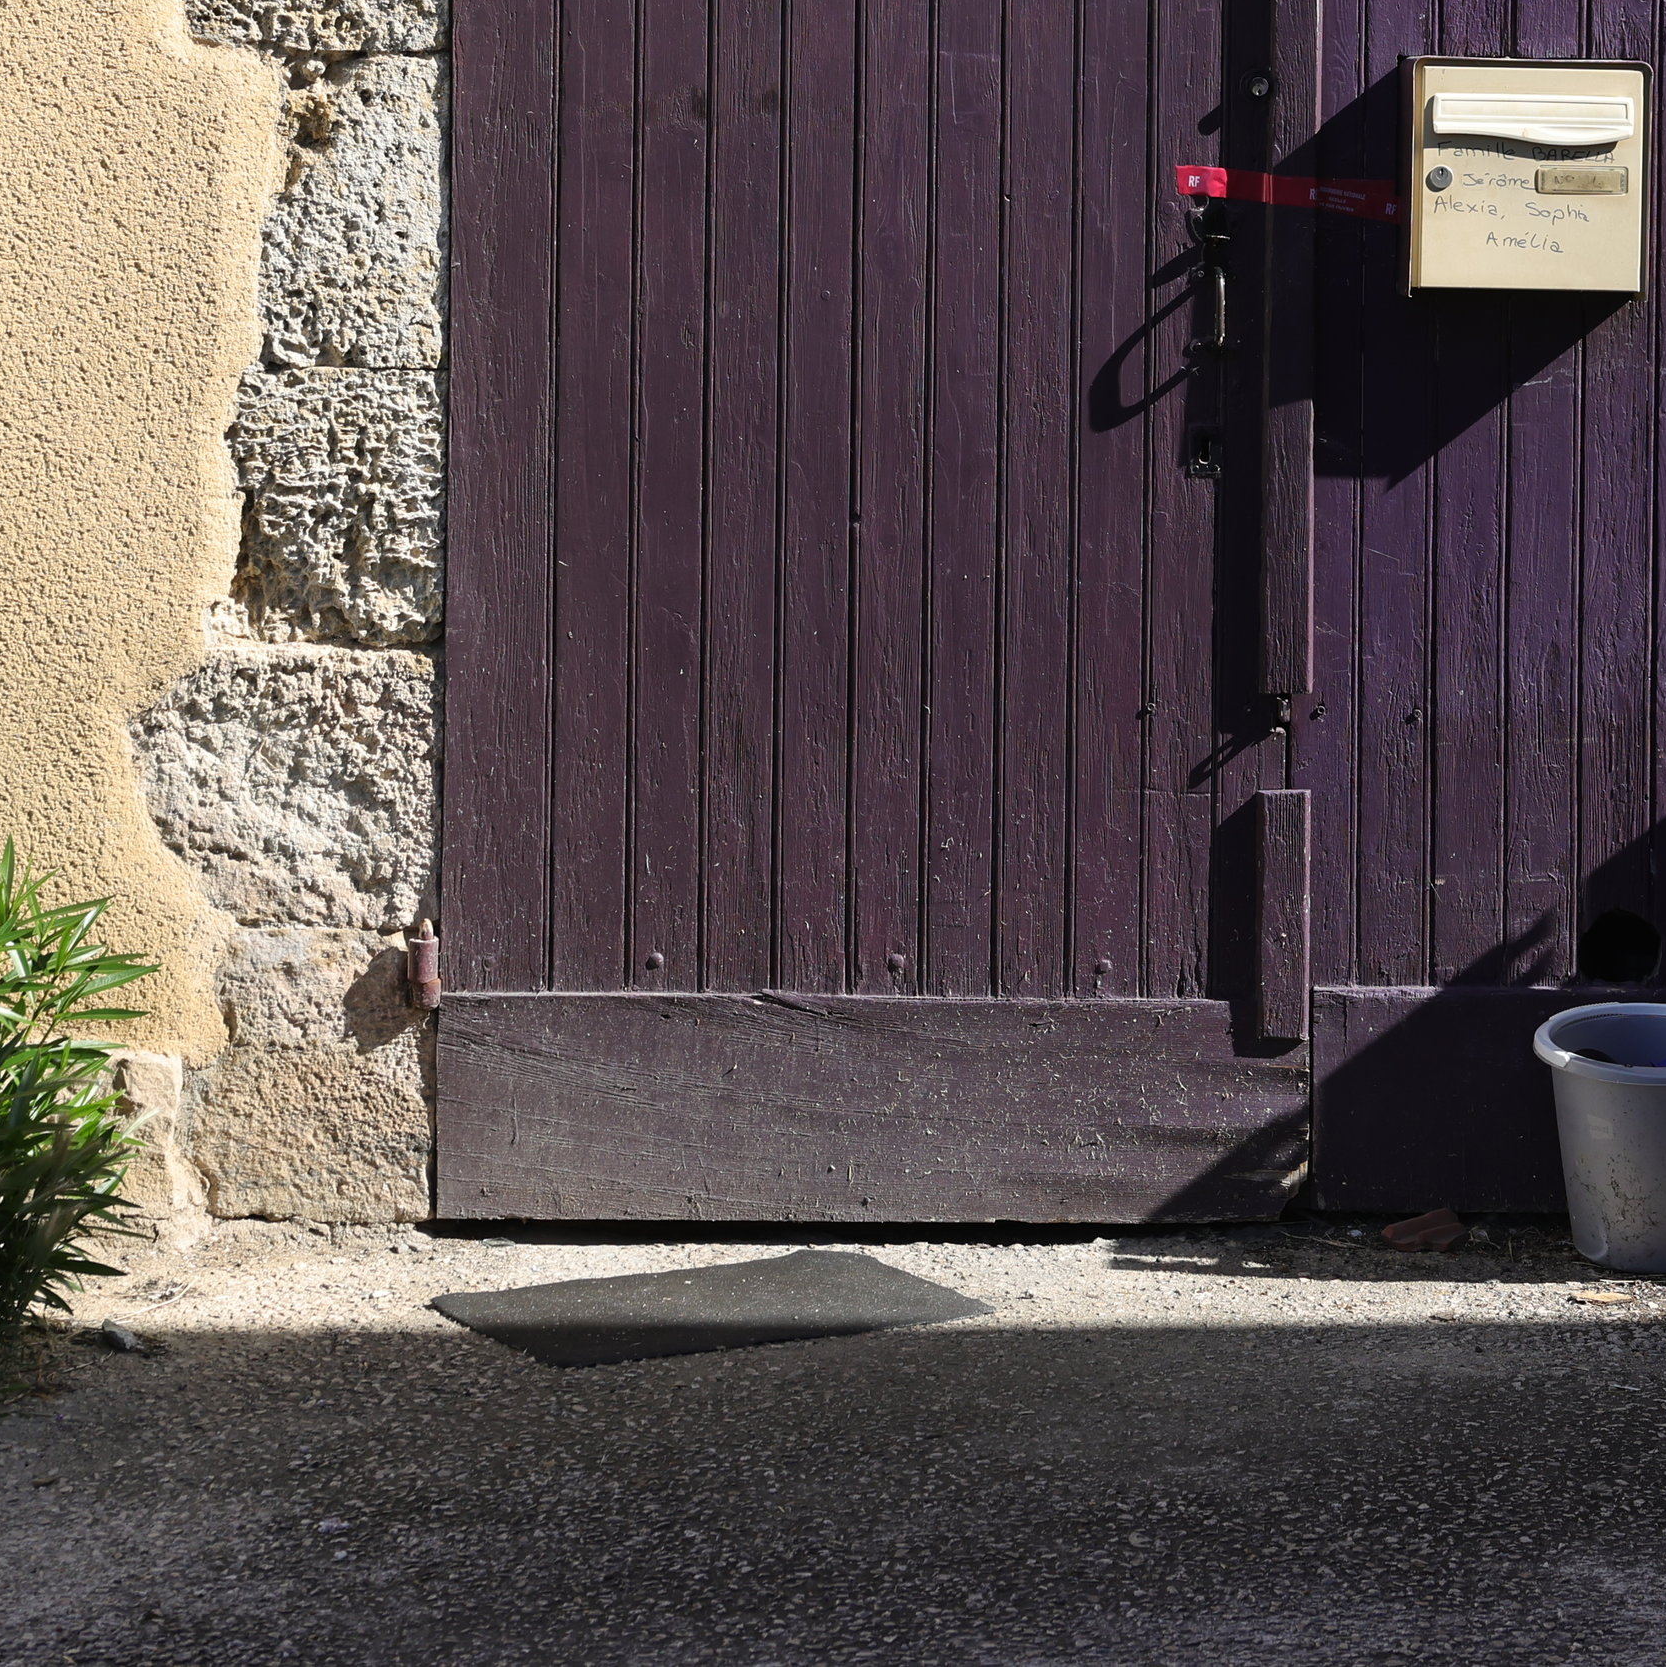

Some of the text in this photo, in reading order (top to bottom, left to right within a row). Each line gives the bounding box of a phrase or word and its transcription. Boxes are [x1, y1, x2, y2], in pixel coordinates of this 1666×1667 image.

[1436, 140, 1616, 164] Famille BARELLA
[1188, 175, 1201, 188] RF
[1462, 172, 1537, 191] Jérôme
[1385, 202, 1398, 215] RF
[1433, 194, 1507, 221] Alexia,
